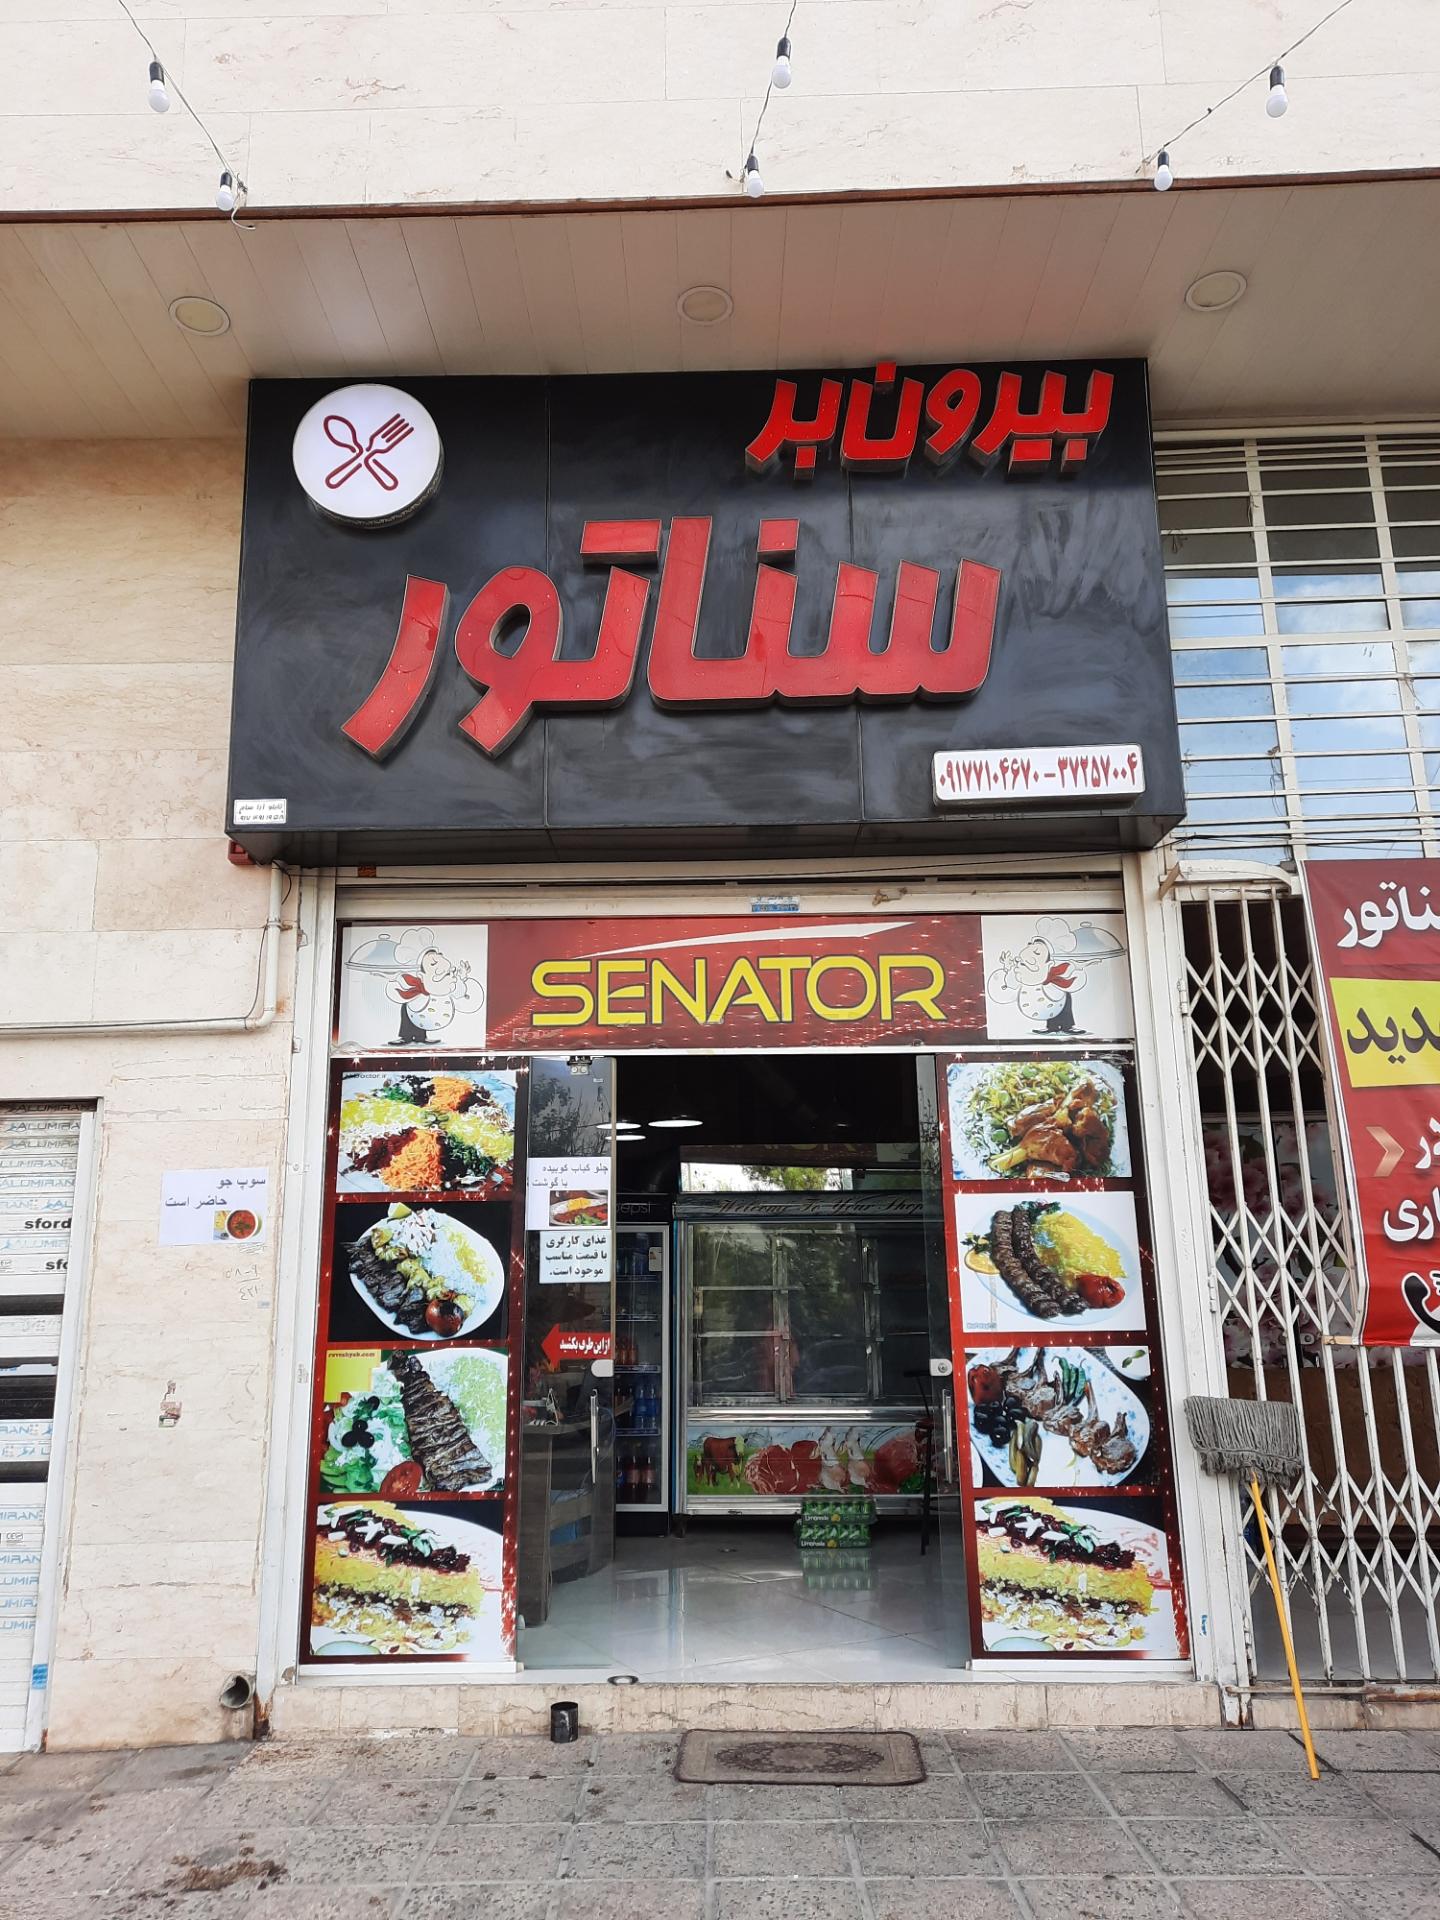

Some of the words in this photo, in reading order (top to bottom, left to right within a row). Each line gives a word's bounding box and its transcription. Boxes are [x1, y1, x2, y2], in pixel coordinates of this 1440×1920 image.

[341, 515, 1001, 756] سناتور
[1337, 881, 1440, 948] ناتور
[531, 953, 948, 1027] SENATOR
[1346, 1006, 1440, 1064] دید
[542, 1164, 568, 1174] کوبیده
[571, 1164, 590, 1174] کباب
[594, 1163, 608, 1175] چلو
[217, 1178, 232, 1189] جو
[236, 1177, 266, 1190] سوپ
[532, 1177, 559, 1189] گوشت
[561, 1178, 568, 1188] با
[165, 1196, 189, 1207] است
[195, 1194, 228, 1209] حاضر
[616, 1201, 650, 1215] epsi
[24, 1217, 72, 1229] sford
[545, 1236, 580, 1249] کارگری
[582, 1235, 607, 1248] غذای
[545, 1251, 573, 1263] مناسب
[576, 1249, 599, 1261] قیمت
[601, 1250, 607, 1261] با
[574, 1269, 603, 1278] موجود
[559, 1336, 579, 1353] بکشید
[579, 1337, 593, 1354] طرف
